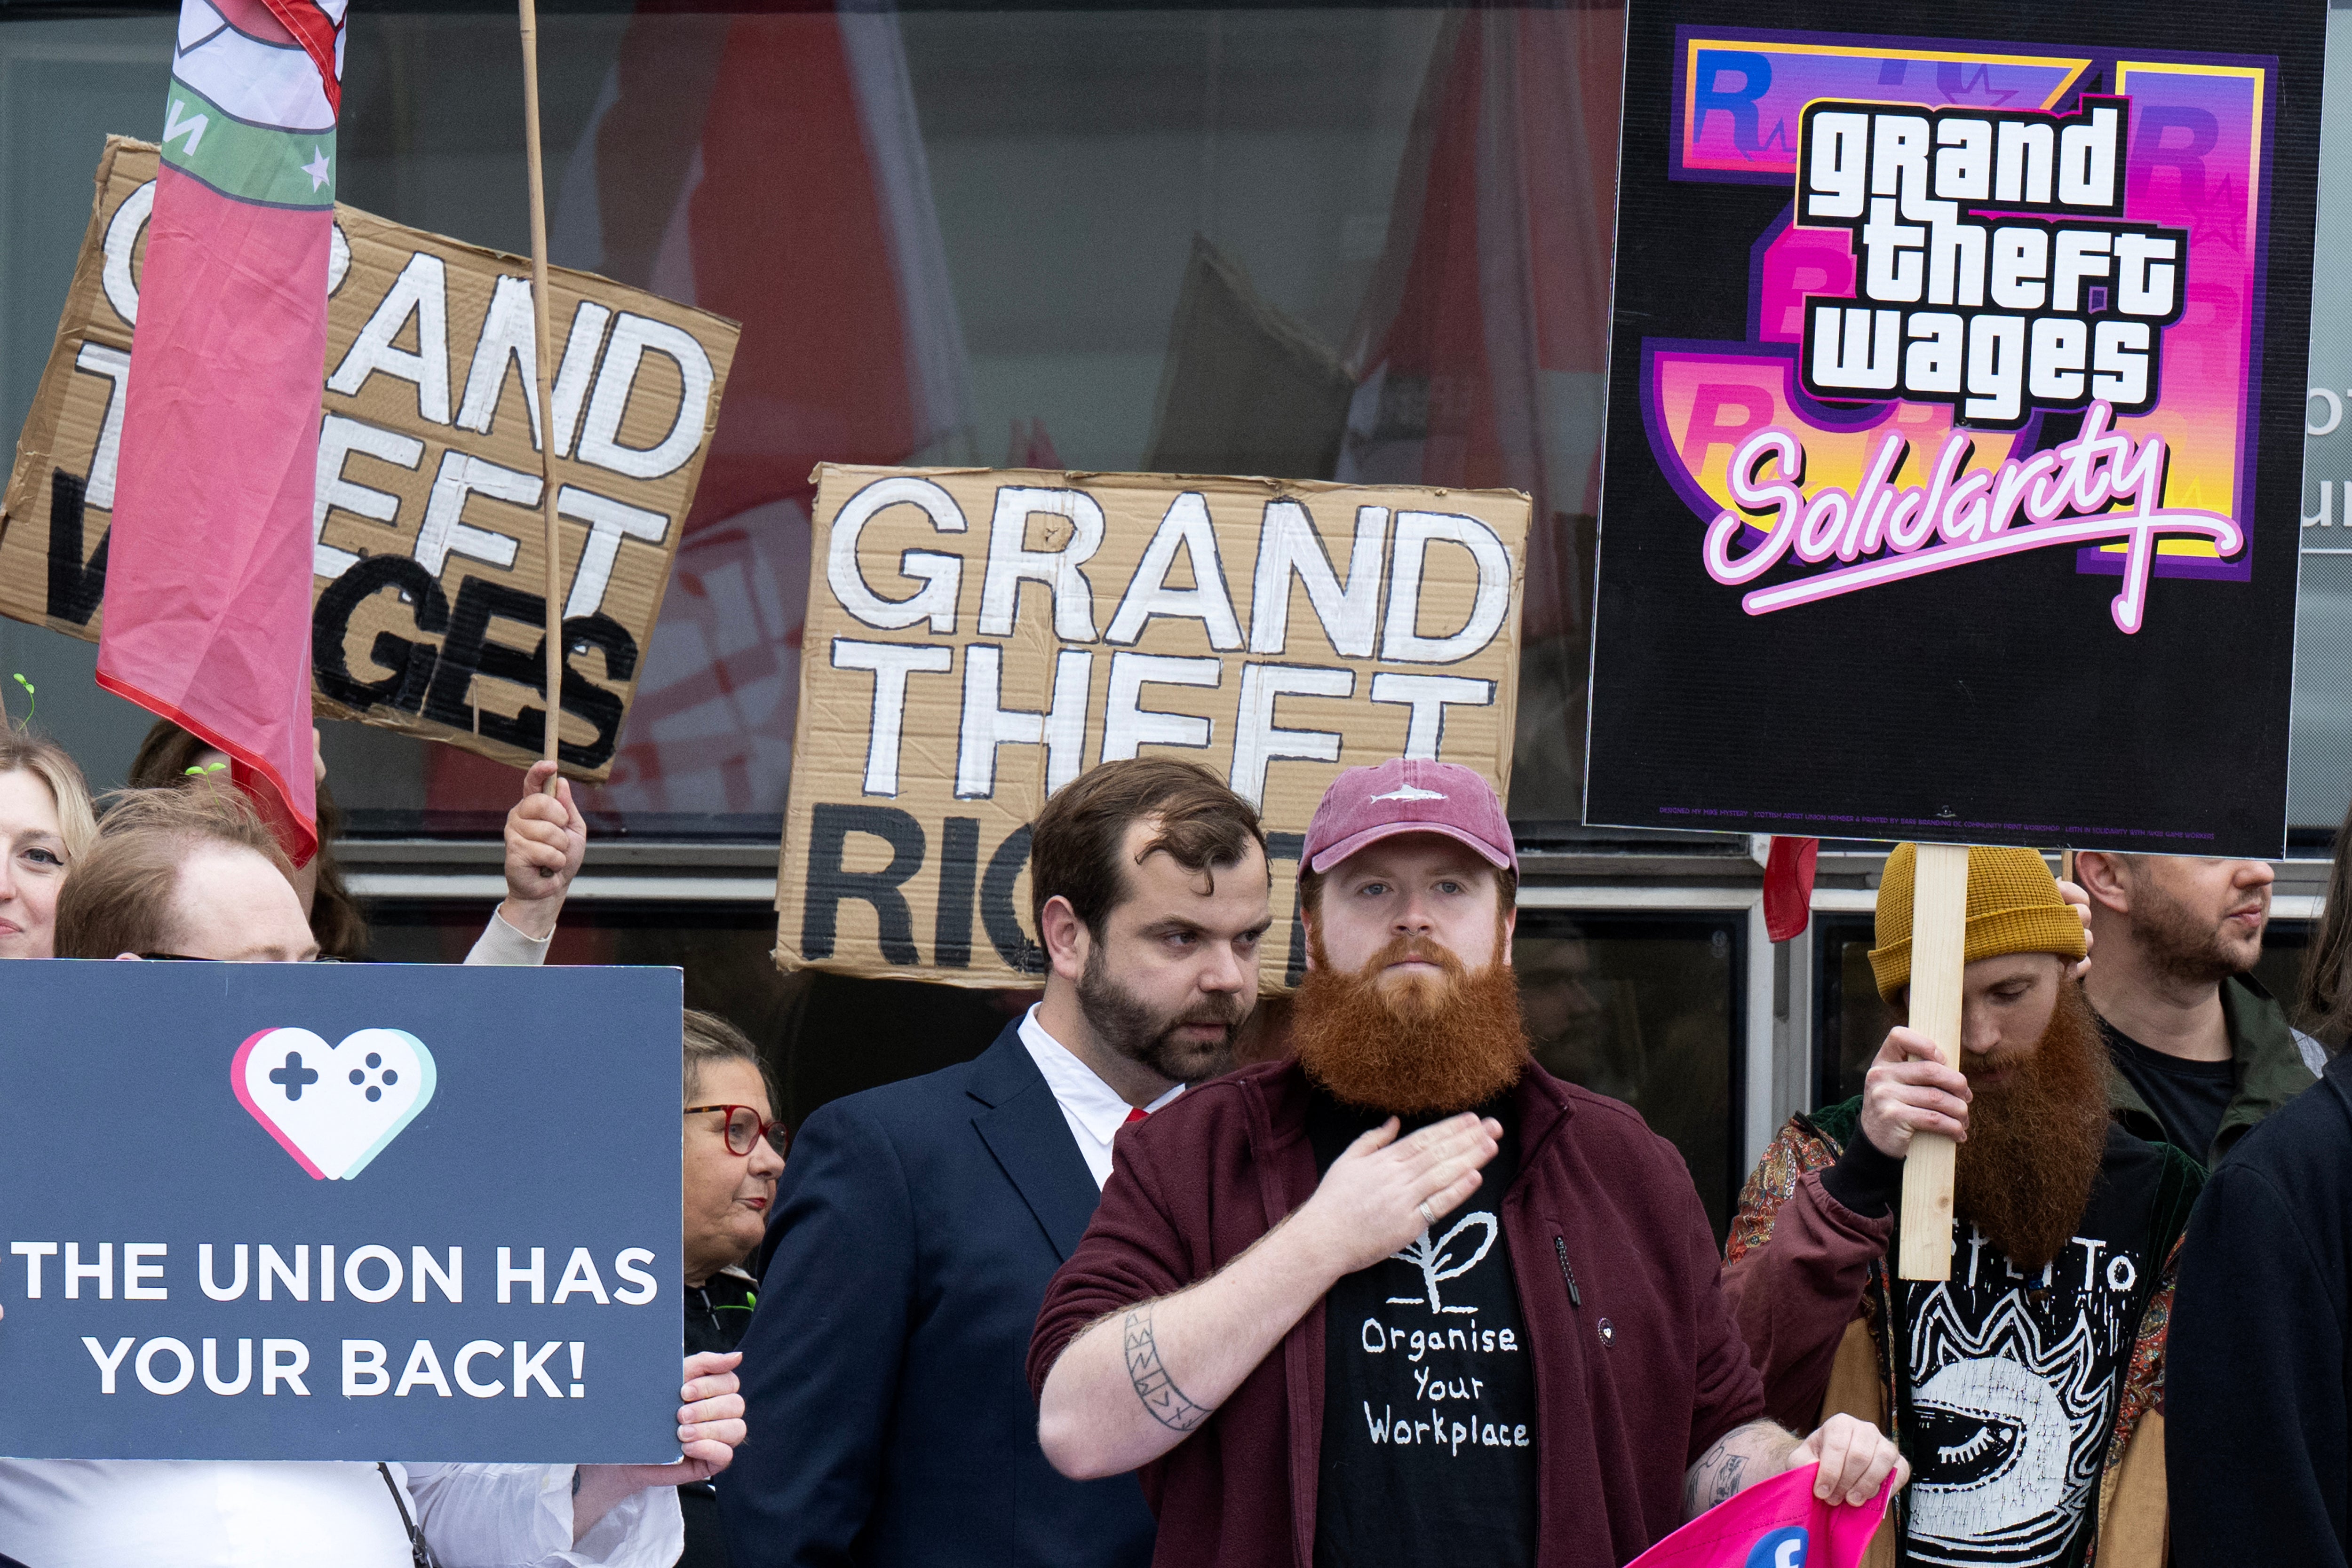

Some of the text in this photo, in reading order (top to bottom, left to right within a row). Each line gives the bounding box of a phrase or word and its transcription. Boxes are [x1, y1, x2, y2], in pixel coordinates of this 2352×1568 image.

[101, 178, 715, 480] AND
[1812, 307, 2150, 420] wages
[1703, 399, 2245, 634] Solidarity
[827, 476, 1511, 665] GRAND
[830, 637, 1498, 817] THEFT
[1754, 810, 1782, 818] SCOTTISH
[10, 1241, 659, 1306] THE UNION HAS
[80, 1336, 586, 1398] YOUR BACK!
[1362, 1318, 1518, 1362] Organise
[1414, 1366, 1484, 1401] Your
[1364, 1401, 1529, 1457] Workplace
